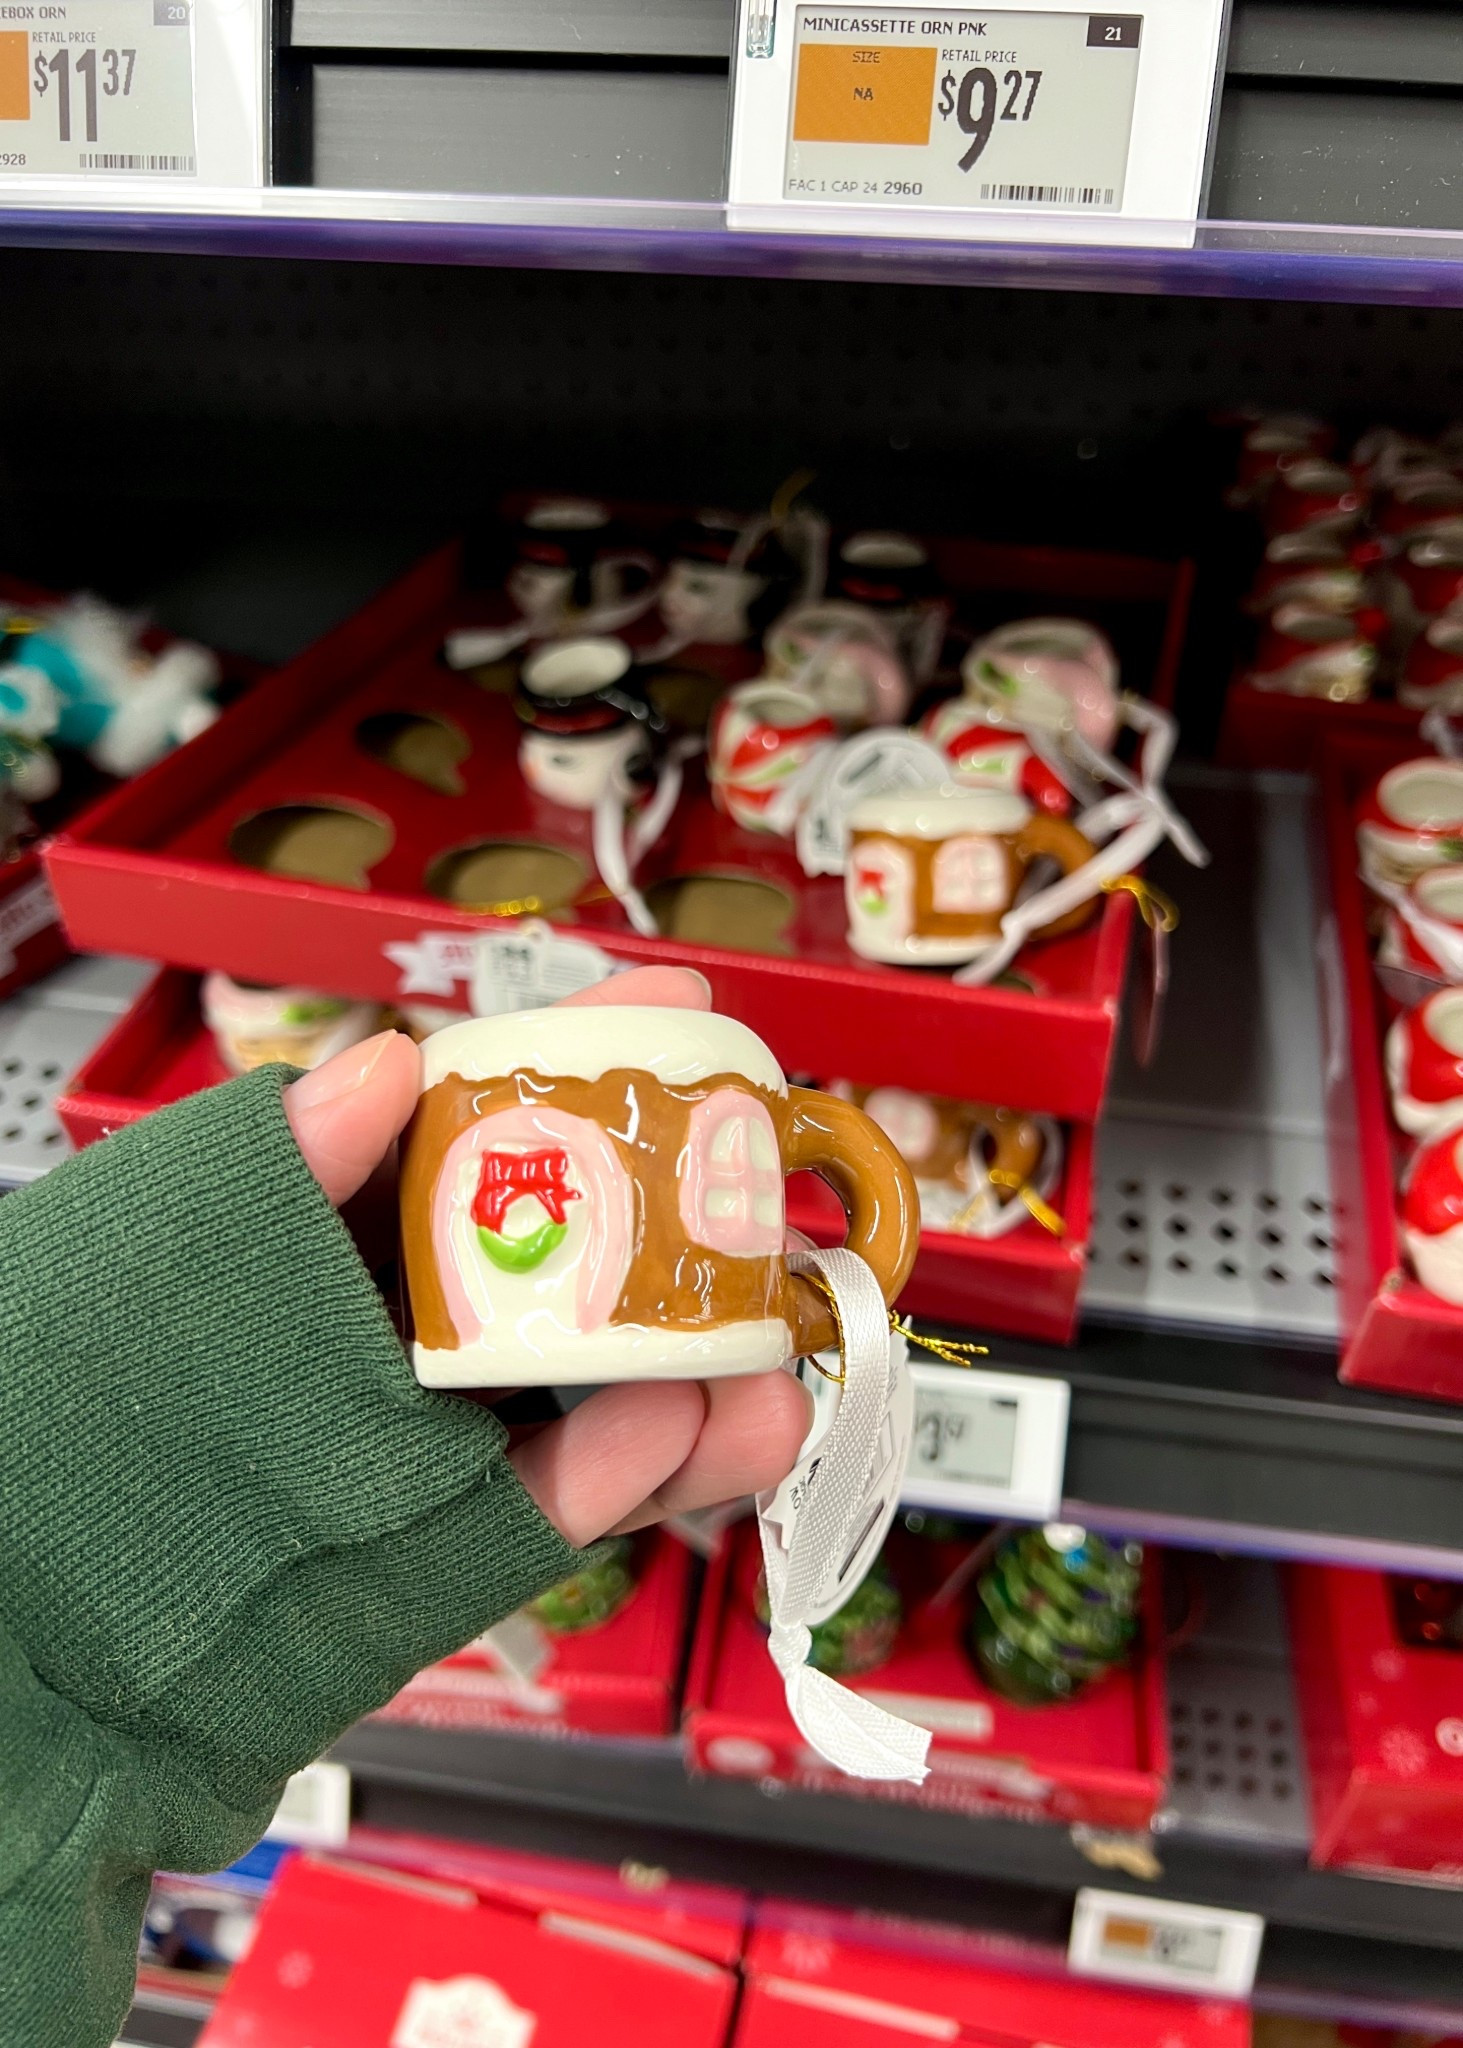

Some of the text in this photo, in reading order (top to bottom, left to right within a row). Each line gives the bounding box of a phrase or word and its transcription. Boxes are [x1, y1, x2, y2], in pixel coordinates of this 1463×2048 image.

[0, 6, 67, 19] EBOX ORN
[168, 7, 186, 19] 20
[803, 17, 987, 36] MINICASSETTE ORN PNK
[32, 31, 96, 43] RETAIL PRICE
[1104, 26, 1122, 42] 21
[852, 51, 881, 63] SIZE
[941, 49, 1017, 63] RETAIL PRICE
[853, 87, 874, 101] NA
[0, 153, 26, 166] 928
[788, 178, 923, 196] FAC 1 CAP 24 2960
